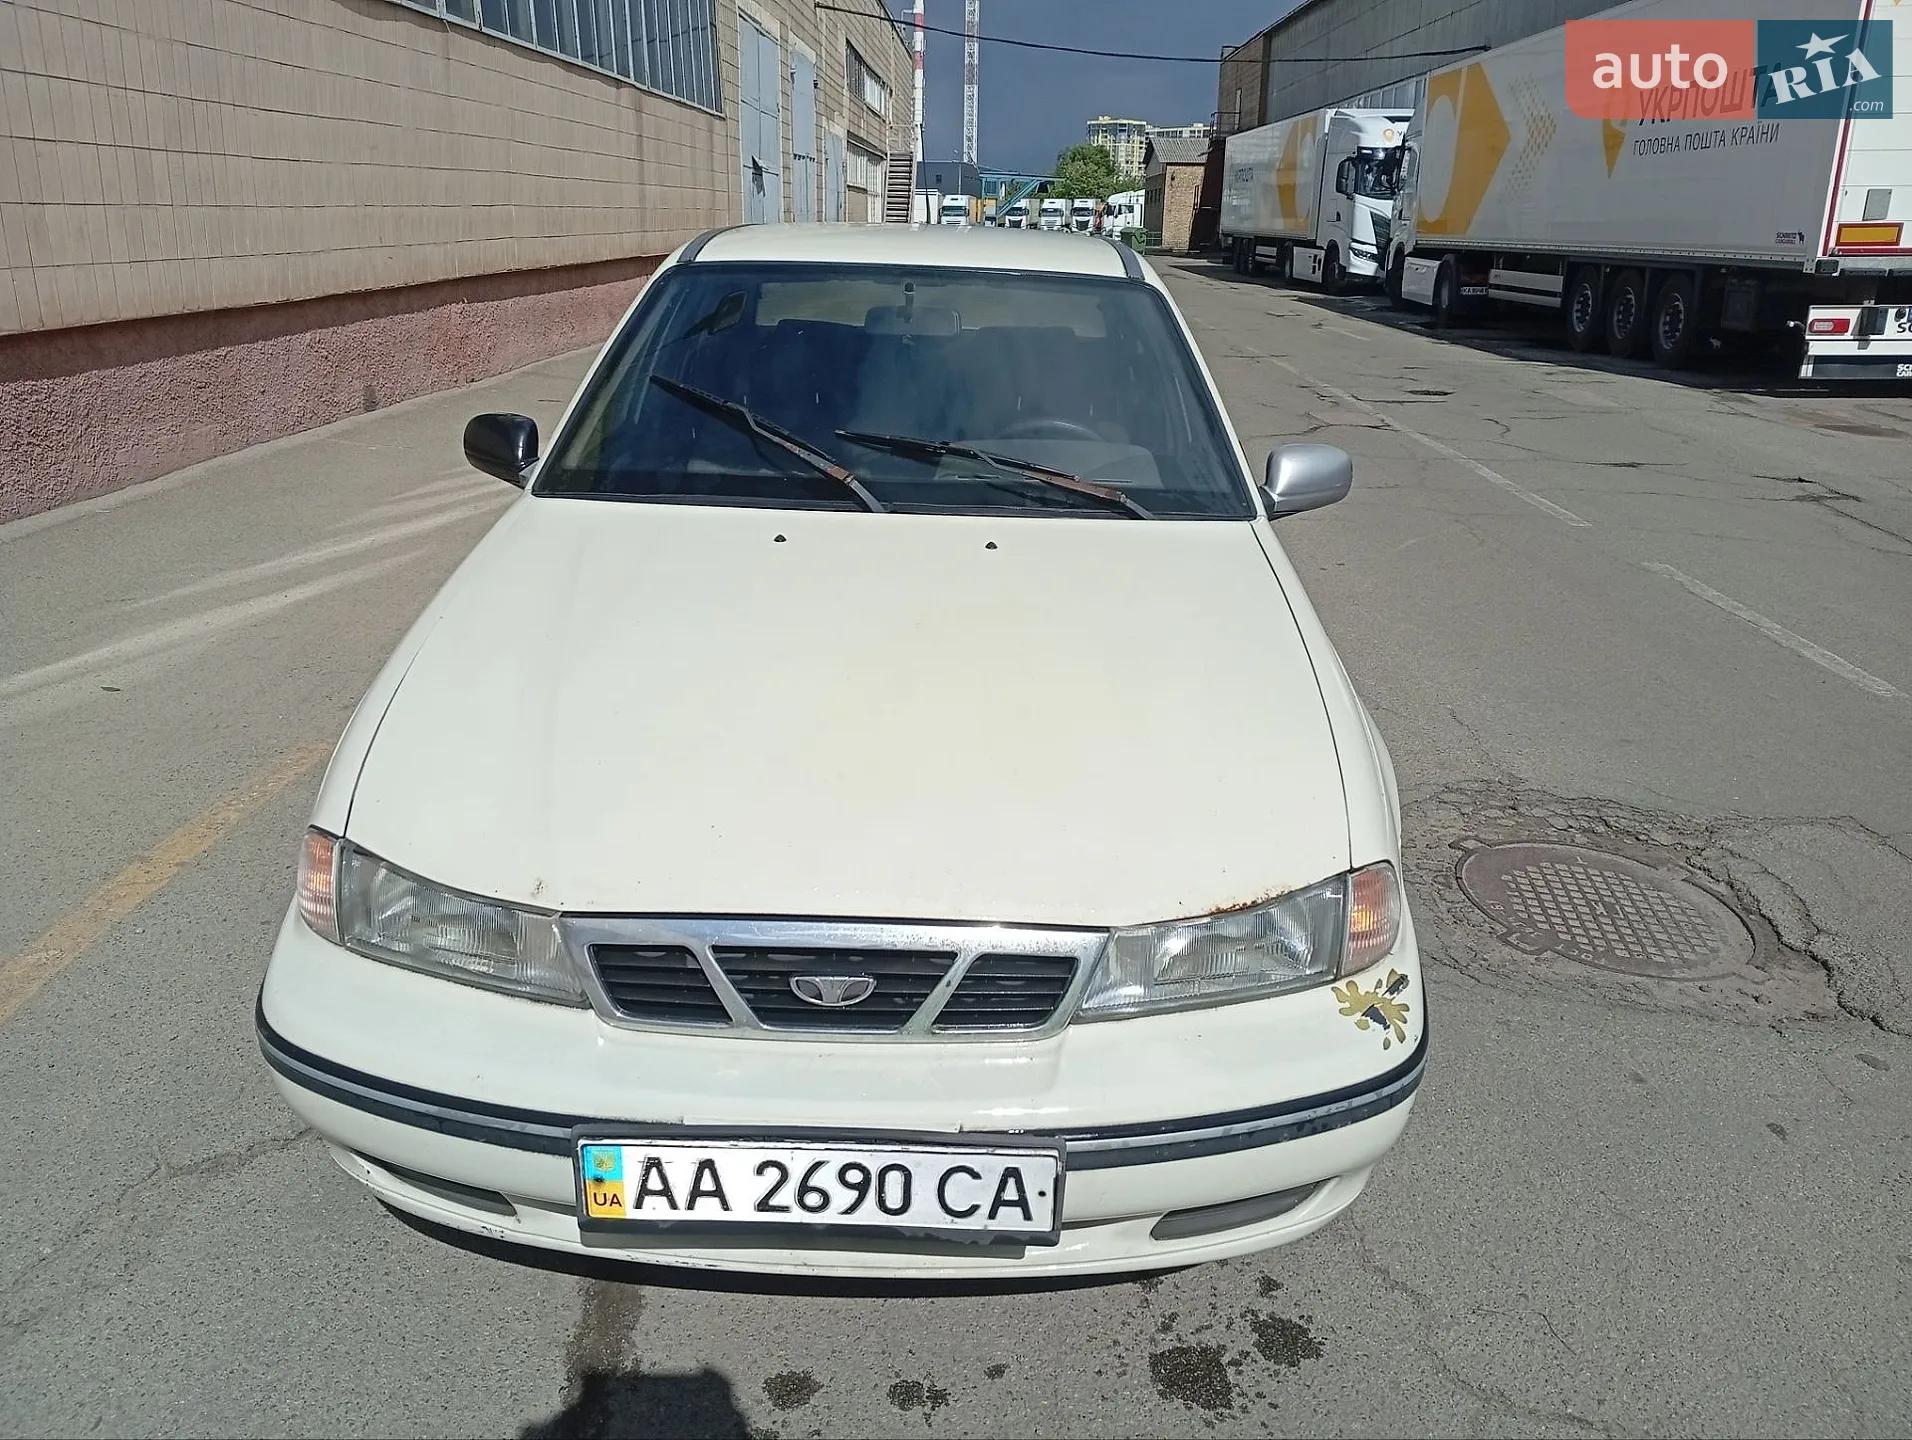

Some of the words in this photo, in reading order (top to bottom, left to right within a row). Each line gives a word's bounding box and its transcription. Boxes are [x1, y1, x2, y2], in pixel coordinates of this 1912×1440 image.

[1633, 136, 1681, 157] ГОЛОВНА
[1684, 129, 1726, 151] ПОШТА
[1730, 120, 1780, 147] КРАЇНИ
[593, 1192, 622, 1207] UA
[633, 1155, 733, 1212] AA
[753, 1159, 913, 1217] 2690
[936, 1164, 1034, 1222] CA
